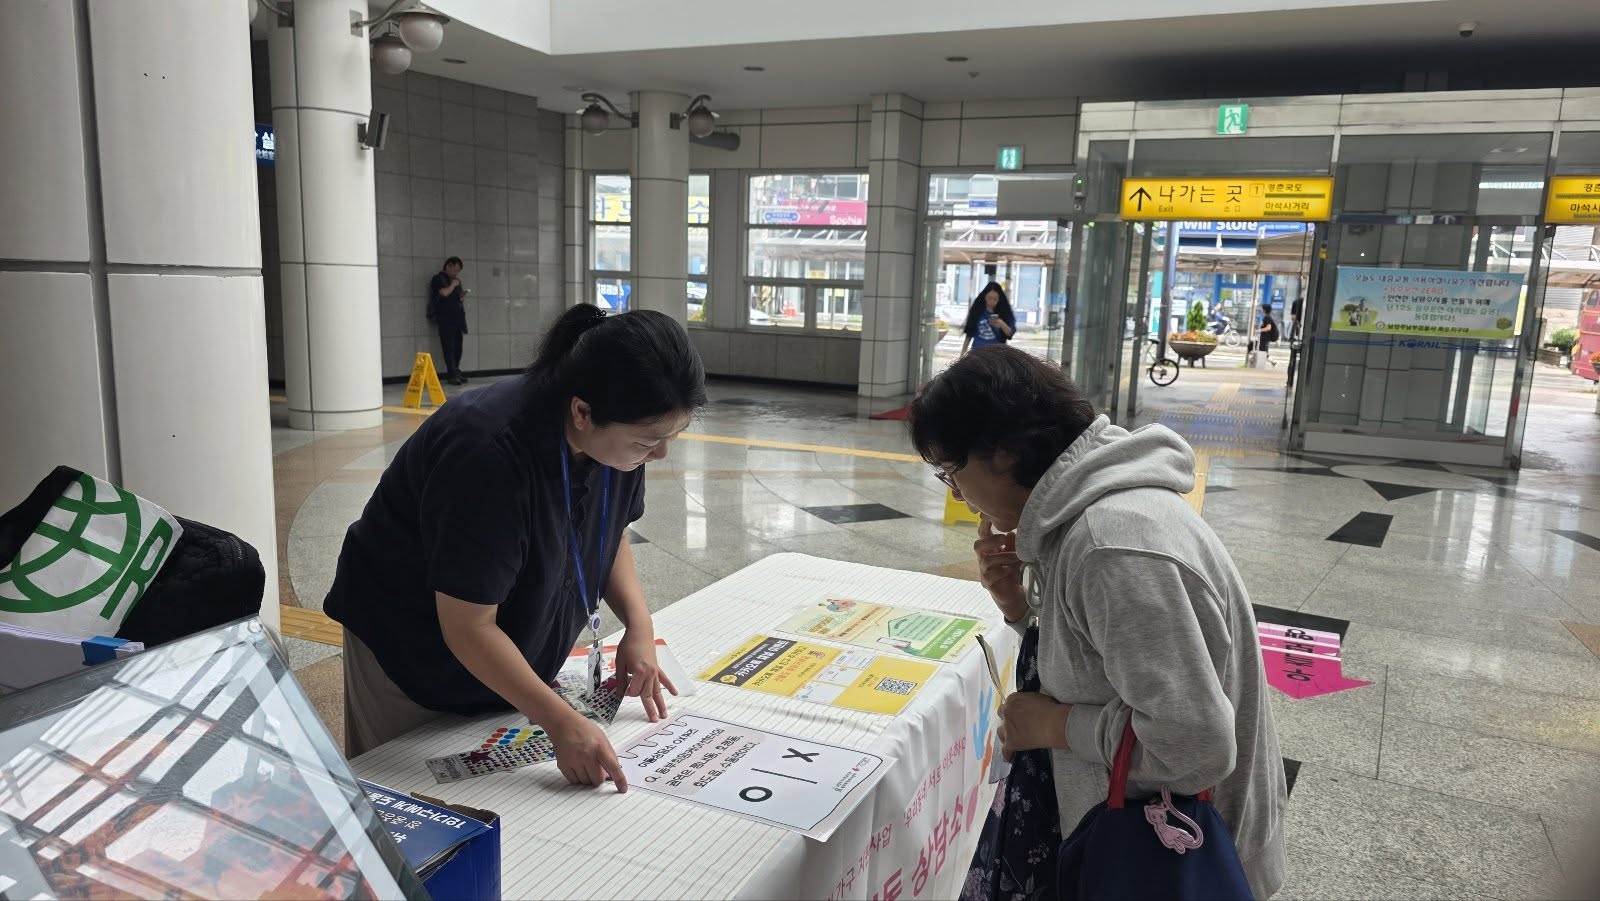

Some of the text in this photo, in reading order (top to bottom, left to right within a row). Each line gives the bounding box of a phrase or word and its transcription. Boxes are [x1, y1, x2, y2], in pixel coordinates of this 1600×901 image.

[1158, 185, 1243, 204] 나가는 곳
[1267, 183, 1303, 193] 경춘국도
[1158, 204, 1174, 213] Exit
[1264, 201, 1310, 211] 마석사거리
[1398, 338, 1441, 350] KORAIL
[638, 728, 699, 767] 이동상담소 OX퀴즈
[782, 748, 820, 763] X
[391, 800, 467, 829] 1인가구에게
[911, 793, 964, 897] 상담소
